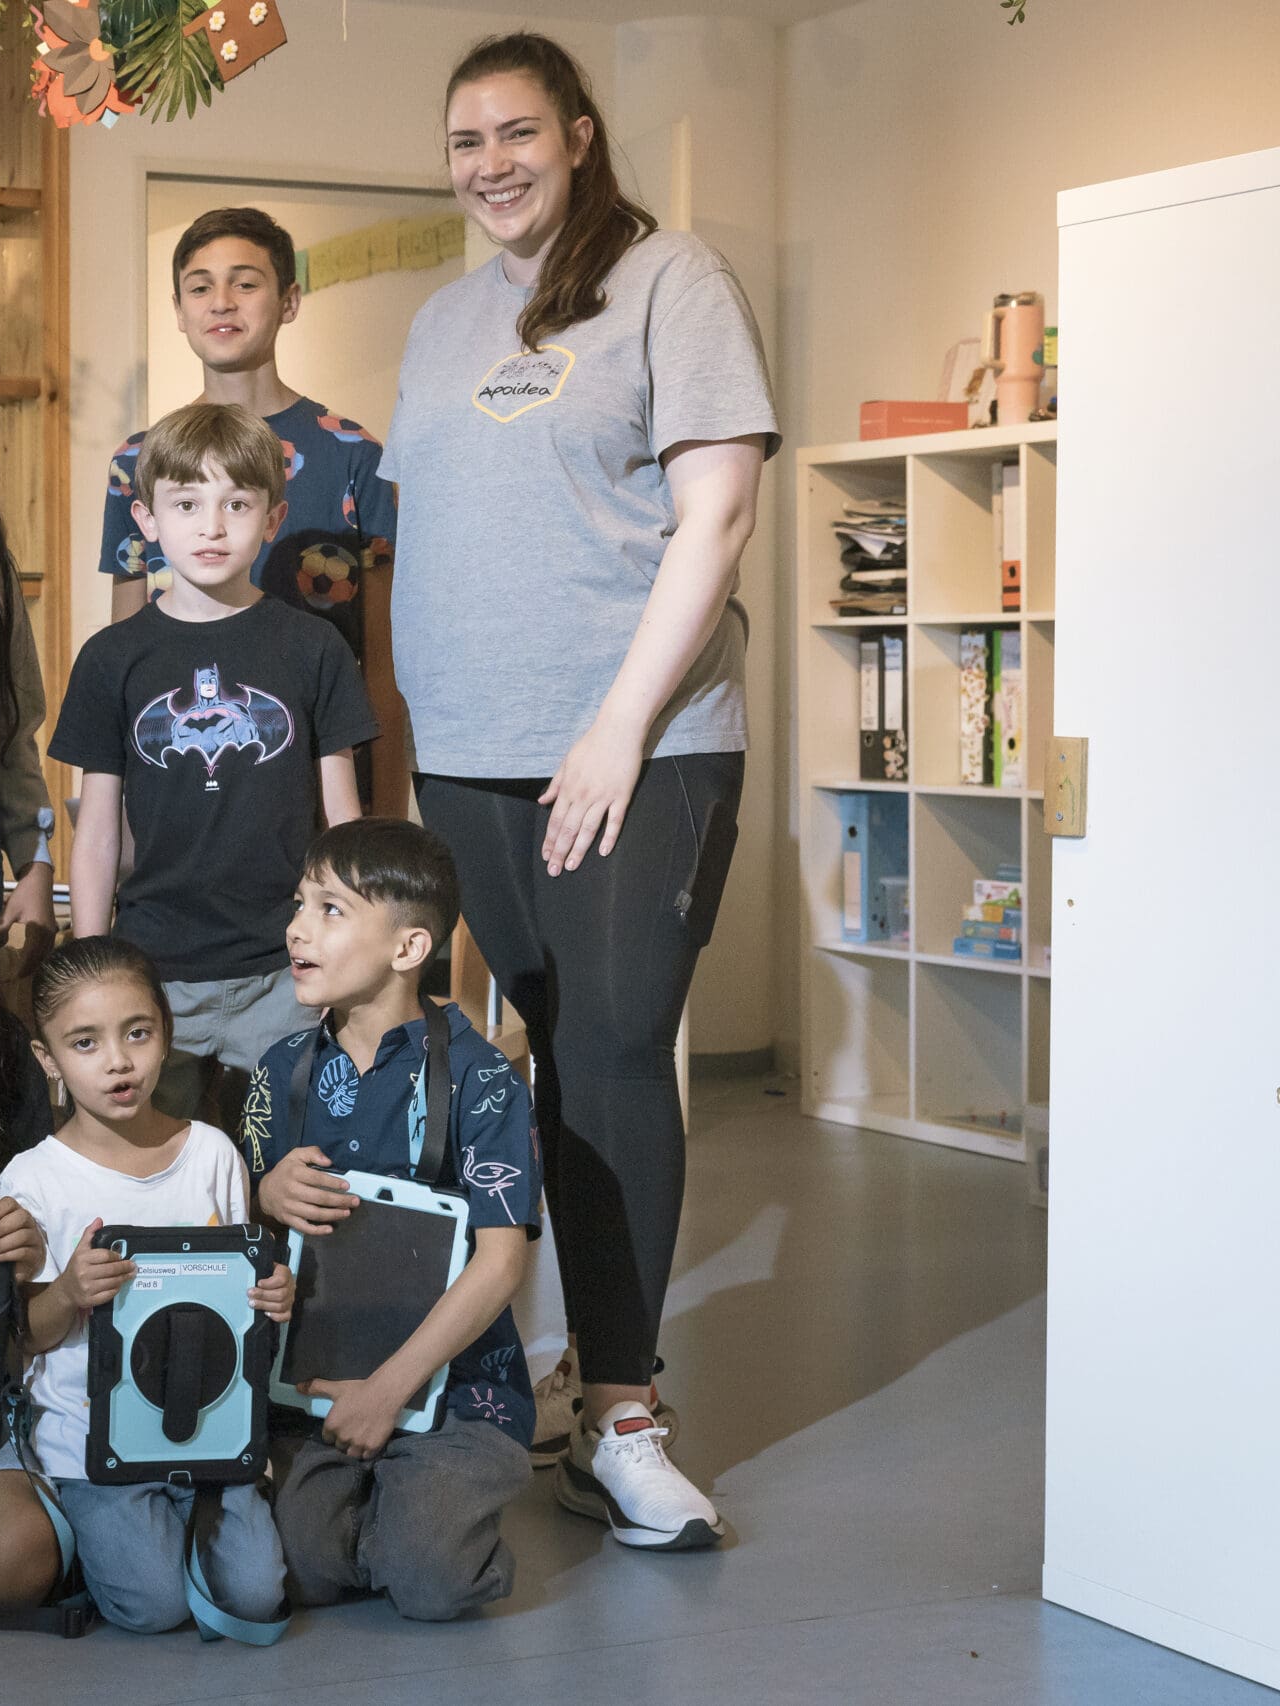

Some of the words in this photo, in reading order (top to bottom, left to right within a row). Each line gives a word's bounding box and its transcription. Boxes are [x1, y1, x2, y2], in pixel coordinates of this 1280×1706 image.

[478, 382, 552, 400] Apoidea
[137, 1267, 176, 1275] Celsiusweg
[182, 1264, 227, 1272] VORSCHULE
